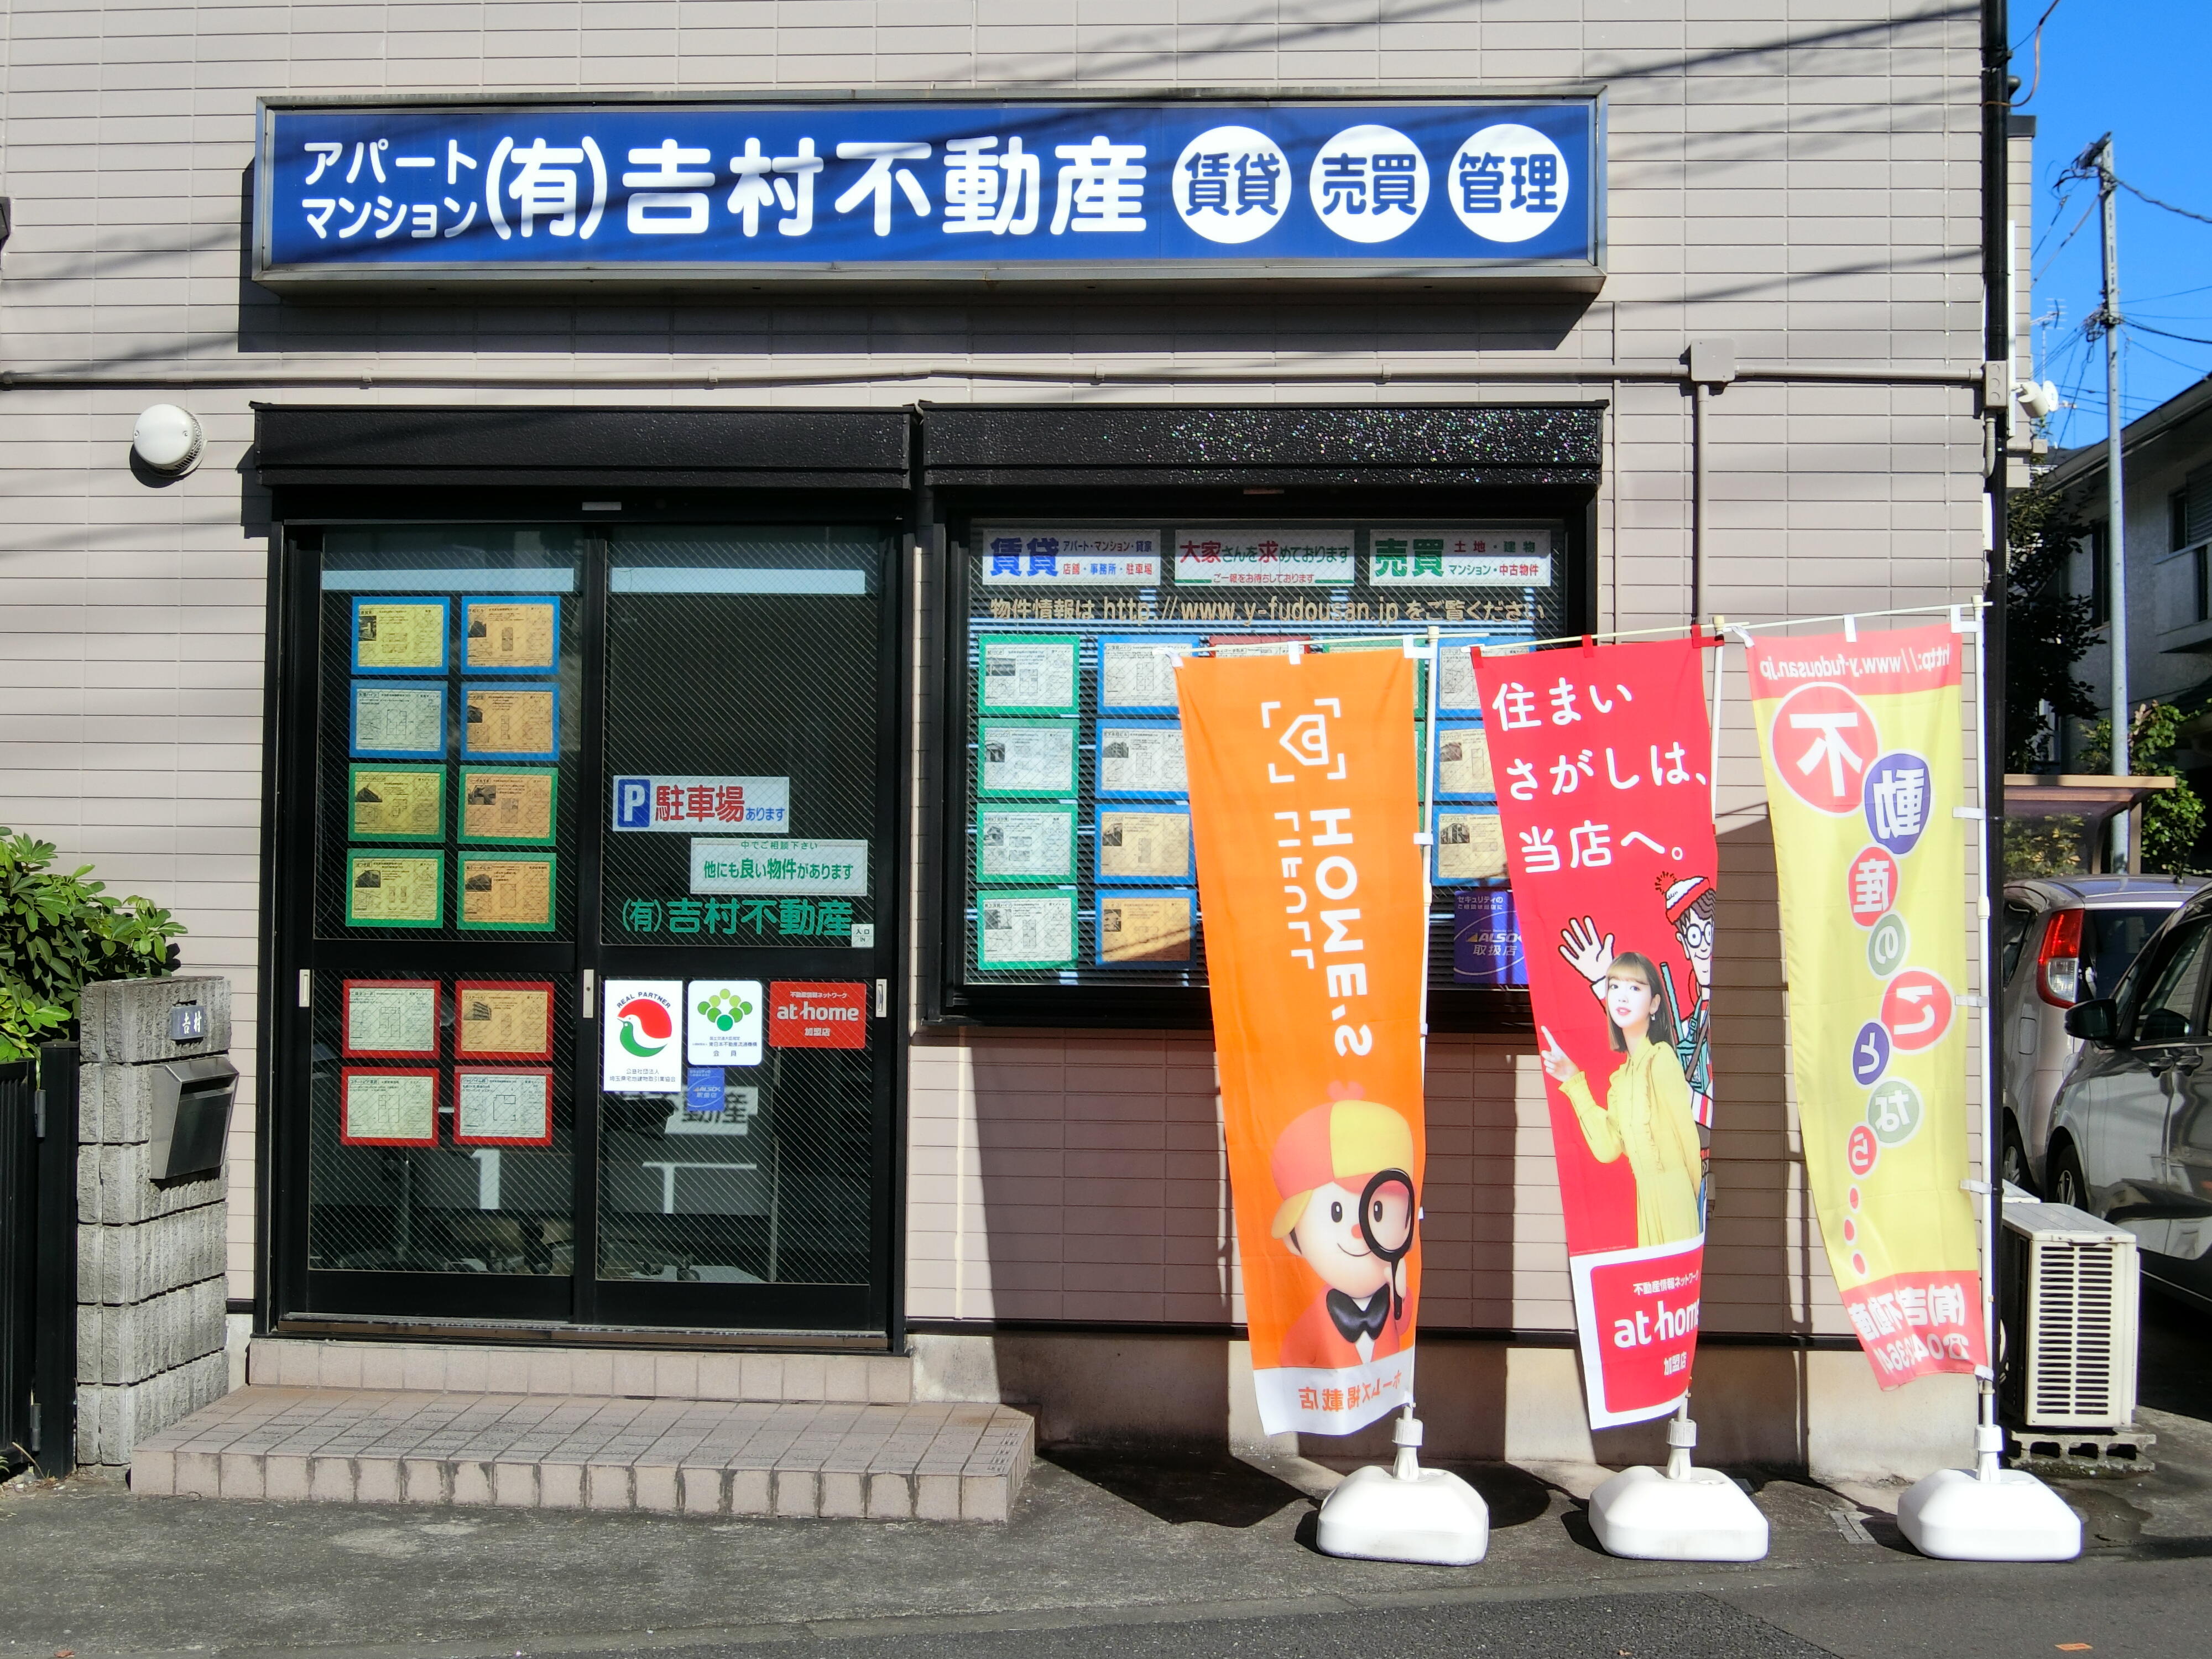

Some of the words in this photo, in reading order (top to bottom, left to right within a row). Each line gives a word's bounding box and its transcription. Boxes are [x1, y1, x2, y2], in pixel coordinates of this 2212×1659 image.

[304, 138, 477, 185] アパート
[1185, 152, 1281, 217] 賃貸
[1322, 153, 1416, 216] 売買
[1459, 152, 1558, 214] 管理
[302, 195, 478, 239] マンション
[990, 538, 1060, 577] 賃貸
[1179, 540, 1350, 564] 大家さんを求めております
[1374, 538, 1445, 577] 売買
[1213, 573, 1315, 584] ご一報をお待ちしております
[1448, 564, 1539, 576] マンション・中古物件
[990, 598, 1095, 620] 物件情報は
[1491, 677, 1632, 732] 住まい
[1506, 742, 1707, 801] さがしは、
[740, 841, 818, 851] 中でご相談下さい
[1519, 820, 1683, 874] 当店へ。
[703, 858, 854, 881] 他にも良い物件があります
[1473, 945, 1517, 956] 取扱店
[617, 994, 635, 1009] REAL
[638, 992, 671, 1009] PARTNER
[804, 1027, 831, 1036] 加盟店
[1663, 1351, 1687, 1376] 加盟店
